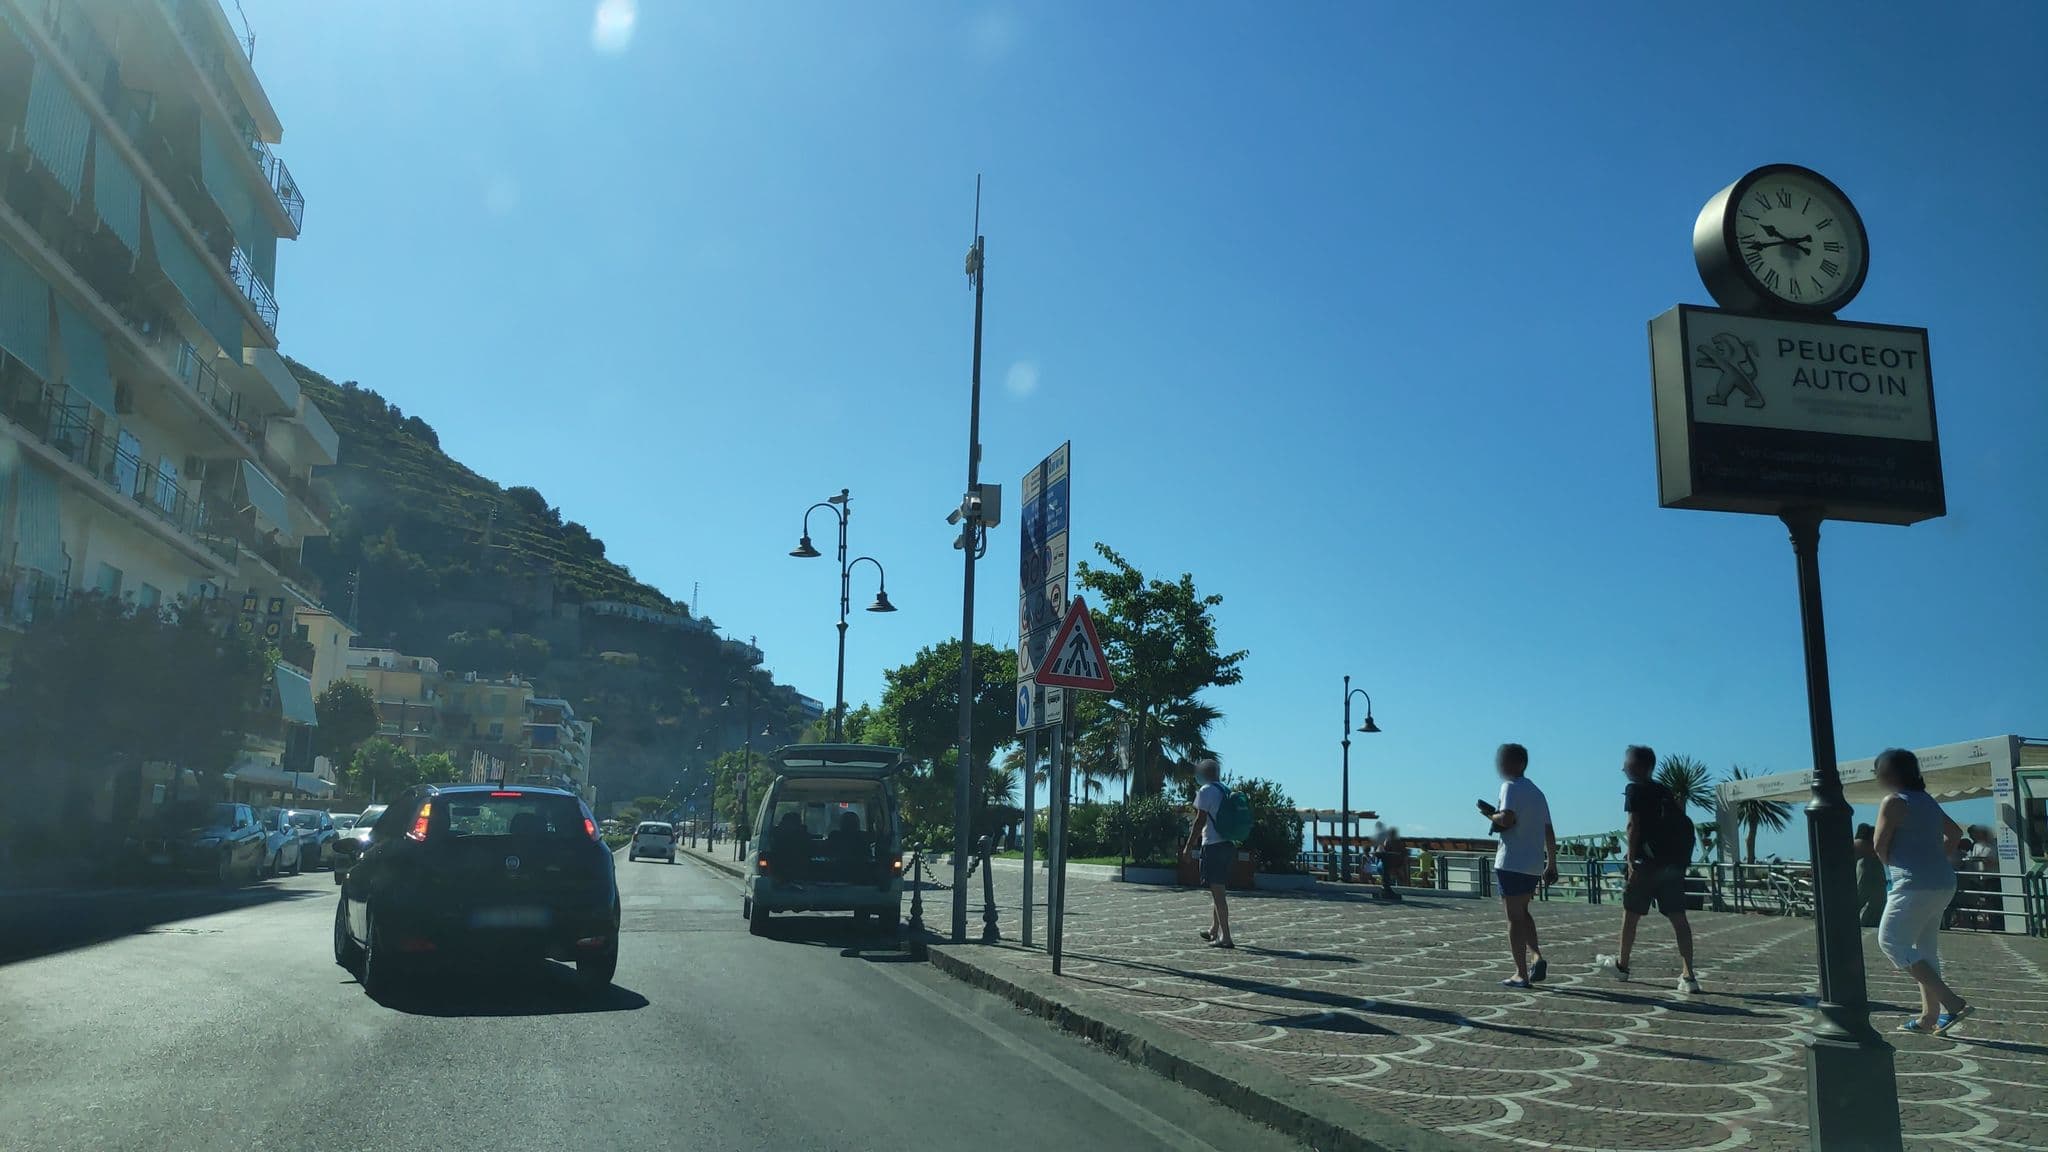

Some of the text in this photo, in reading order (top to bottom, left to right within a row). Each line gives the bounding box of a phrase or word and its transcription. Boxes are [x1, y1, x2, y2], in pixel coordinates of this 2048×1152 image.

[1777, 337, 1918, 369] PEUGEOT
[1792, 367, 1907, 396] AUTO IN
